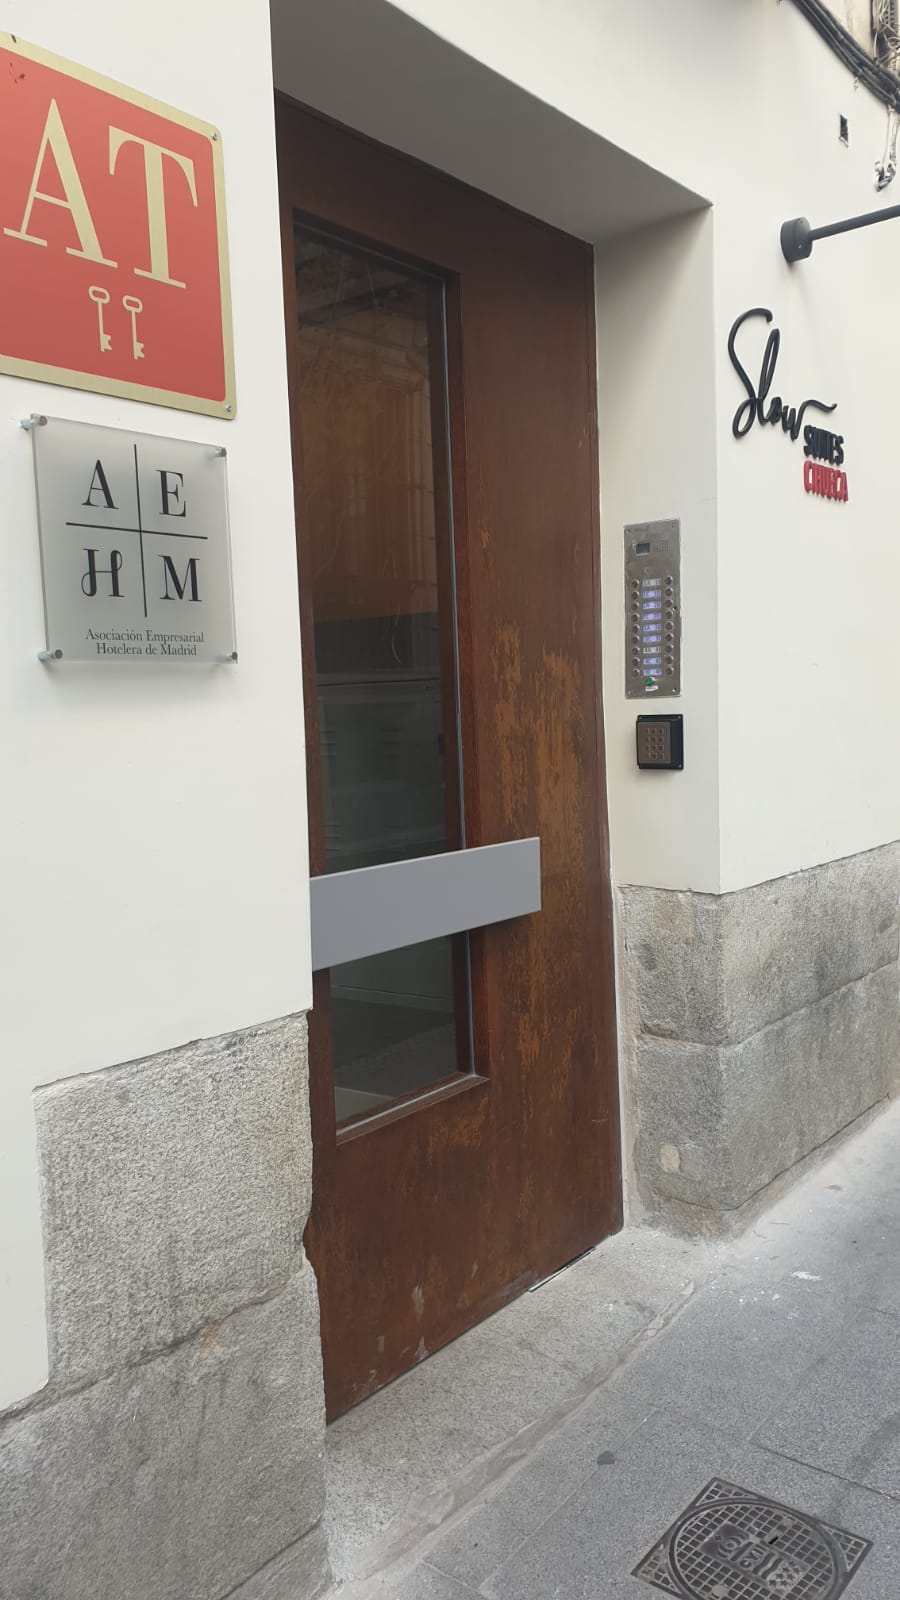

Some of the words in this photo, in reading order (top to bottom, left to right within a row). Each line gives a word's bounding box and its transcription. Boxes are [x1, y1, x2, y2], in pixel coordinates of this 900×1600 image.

[3, 97, 198, 289] AT
[728, 307, 838, 441] Slow
[85, 628, 143, 641] Asociación
[146, 629, 205, 645] Empresarial
[96, 642, 142, 655] Hotelera
[145, 643, 158, 656] de
[160, 643, 198, 656] Madrid
